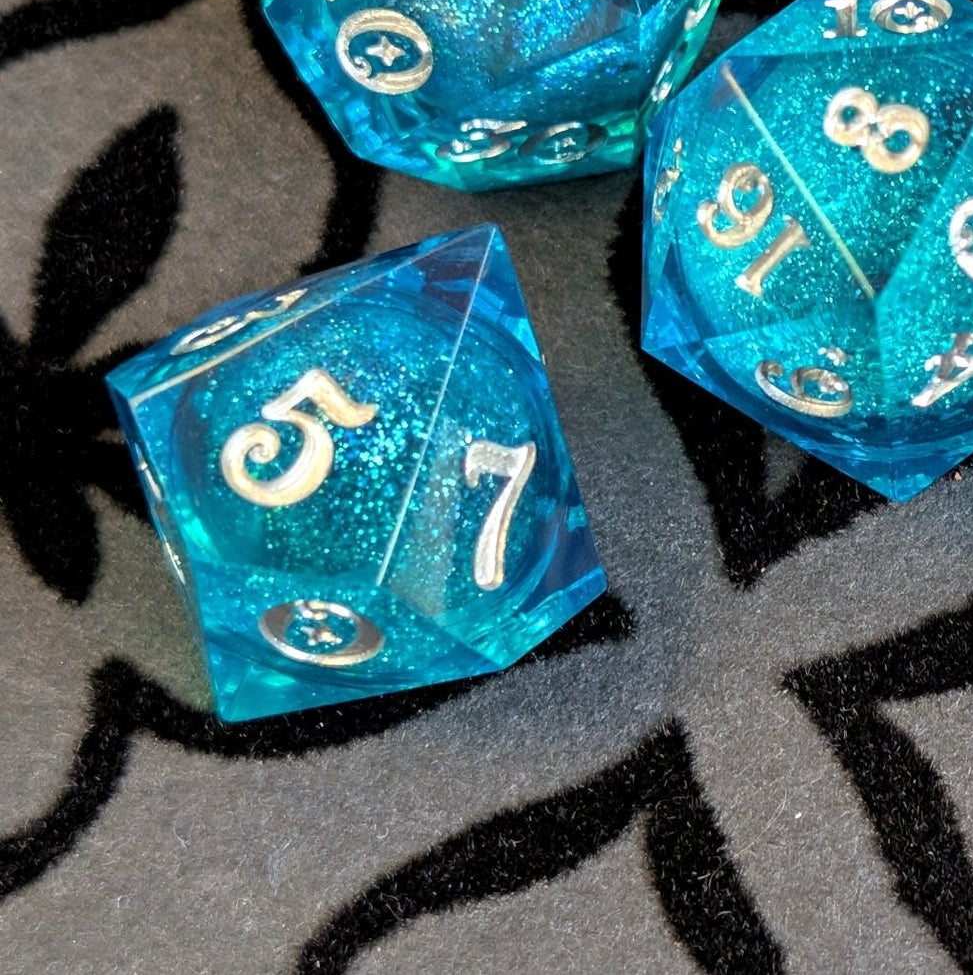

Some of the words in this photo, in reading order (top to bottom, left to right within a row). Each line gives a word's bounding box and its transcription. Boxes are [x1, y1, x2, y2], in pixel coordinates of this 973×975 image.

[823, 86, 930, 174] 8
[220, 369, 377, 507] 5
[464, 440, 537, 591] 7
[259, 600, 384, 669] 0
